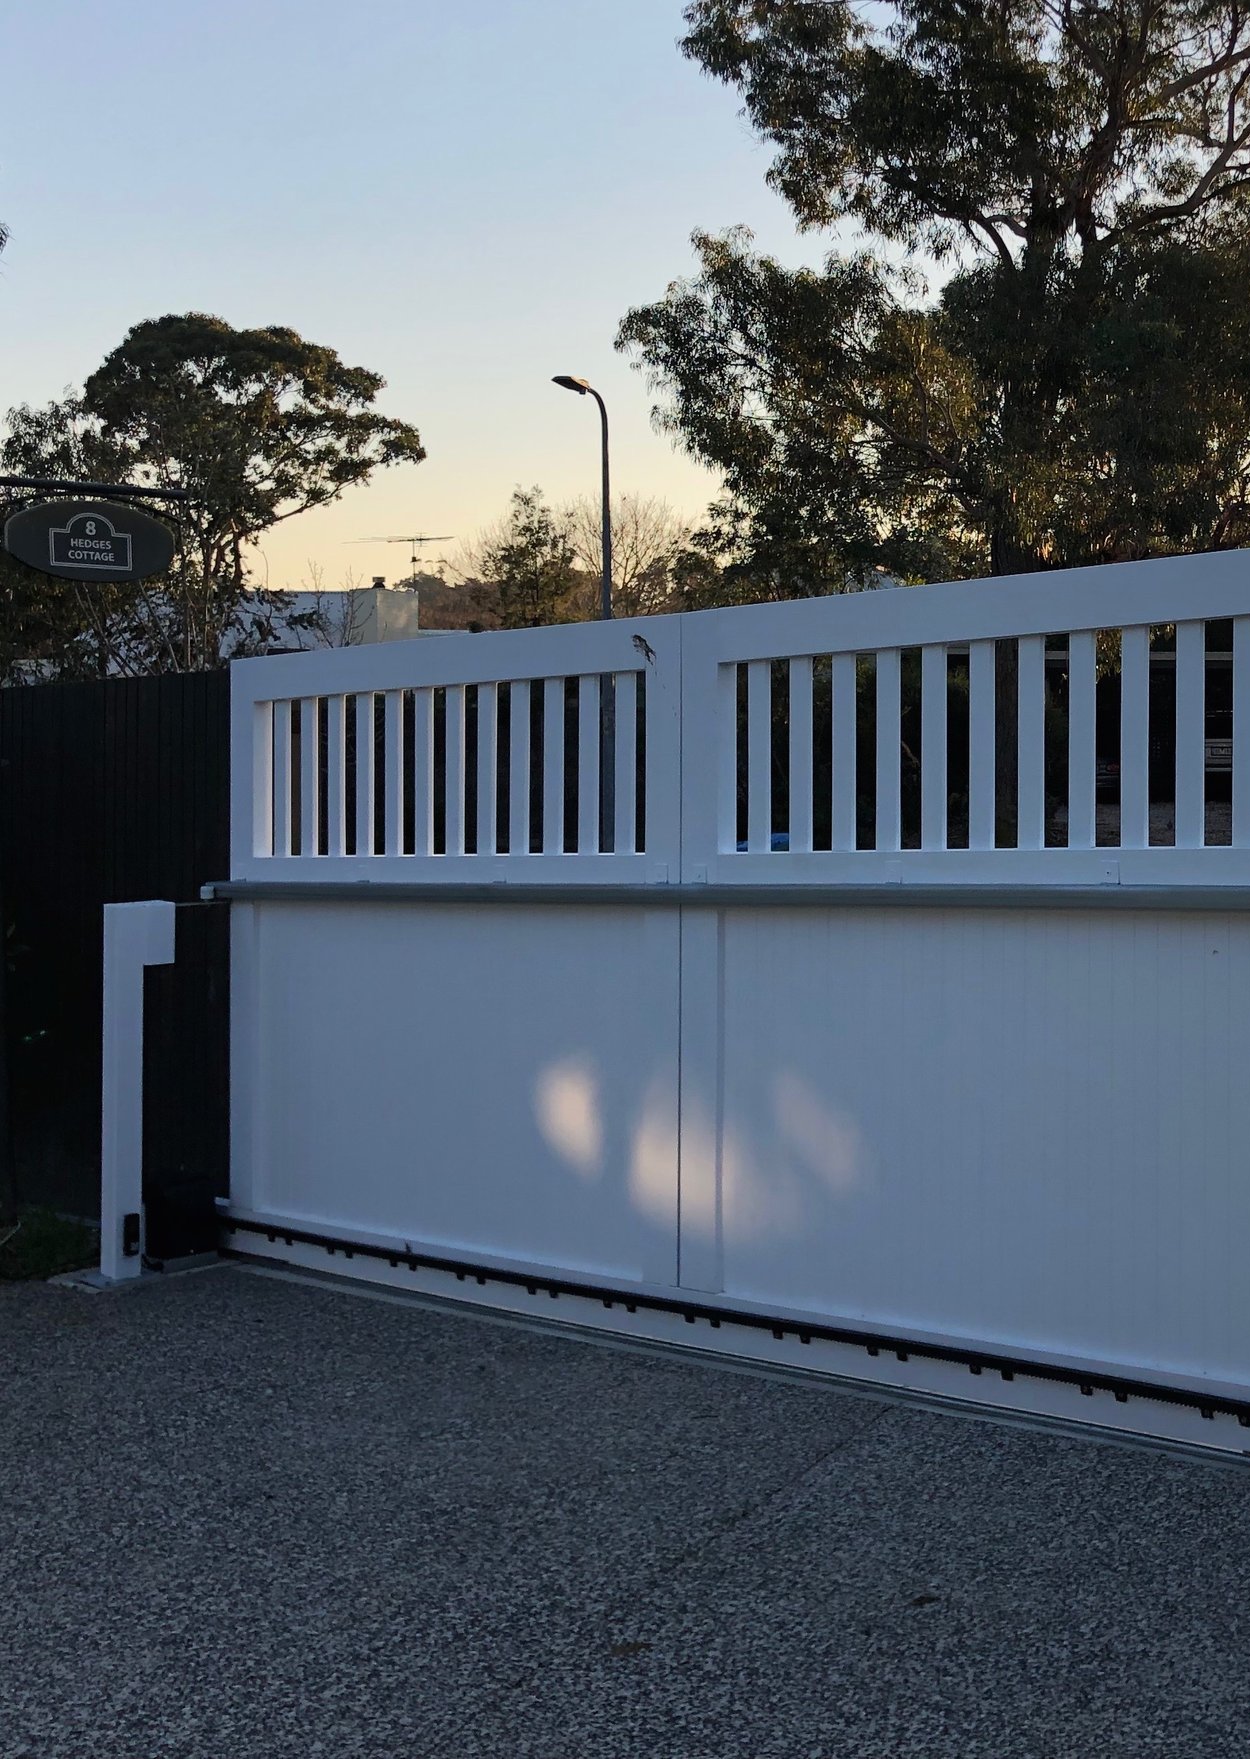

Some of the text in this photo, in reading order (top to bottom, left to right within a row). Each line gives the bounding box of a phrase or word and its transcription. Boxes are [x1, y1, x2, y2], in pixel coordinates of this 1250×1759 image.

[85, 521, 96, 536] 8
[70, 538, 112, 550] HEDGES
[68, 550, 115, 562] COTTAGE
